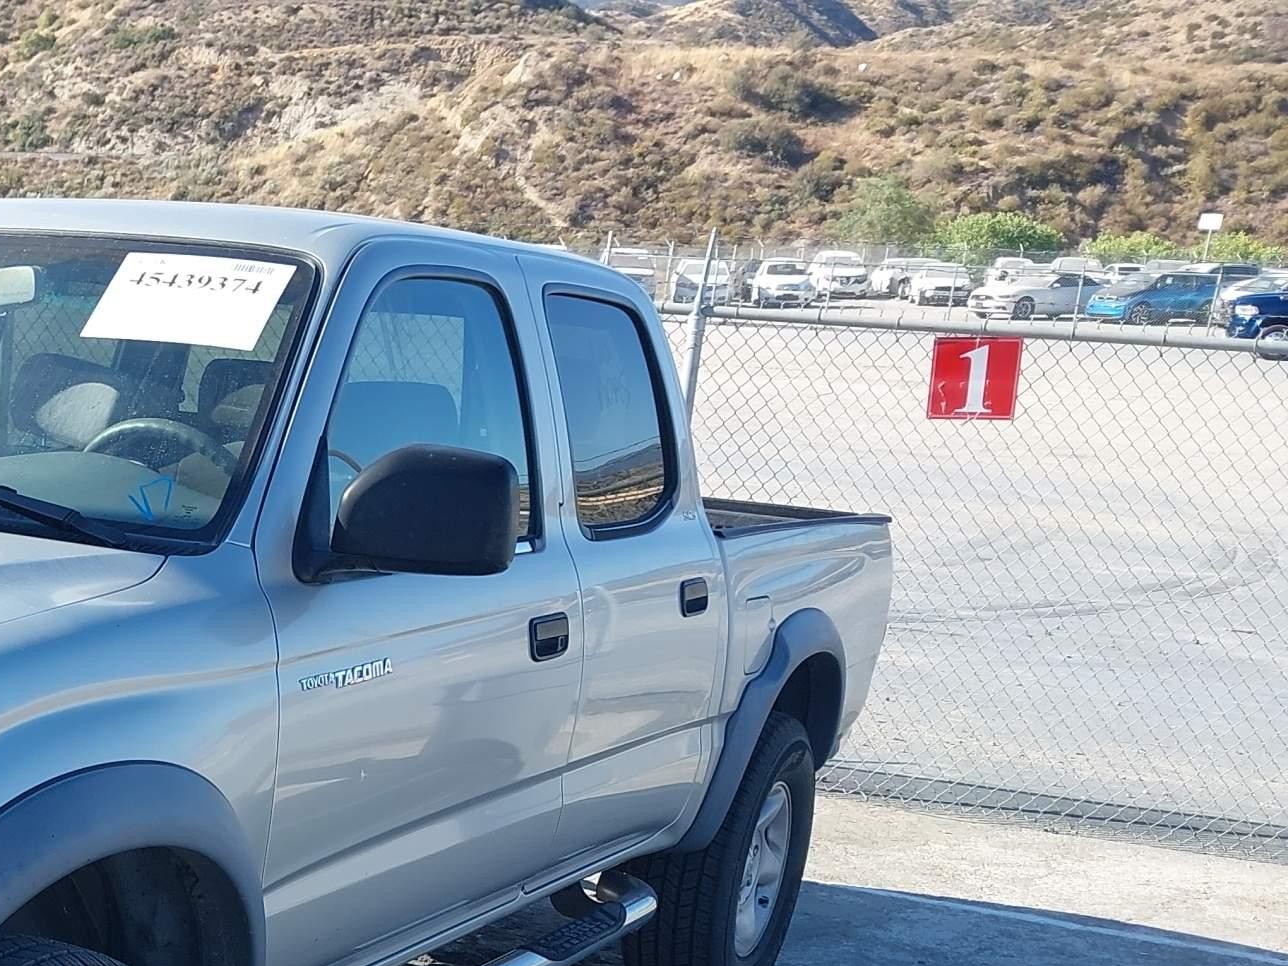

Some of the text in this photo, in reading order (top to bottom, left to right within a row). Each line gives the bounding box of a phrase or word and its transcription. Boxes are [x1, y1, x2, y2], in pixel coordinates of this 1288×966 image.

[130, 271, 263, 294] 45439374
[956, 344, 992, 413] 1
[298, 657, 393, 691] TOYOTA TACOMA
